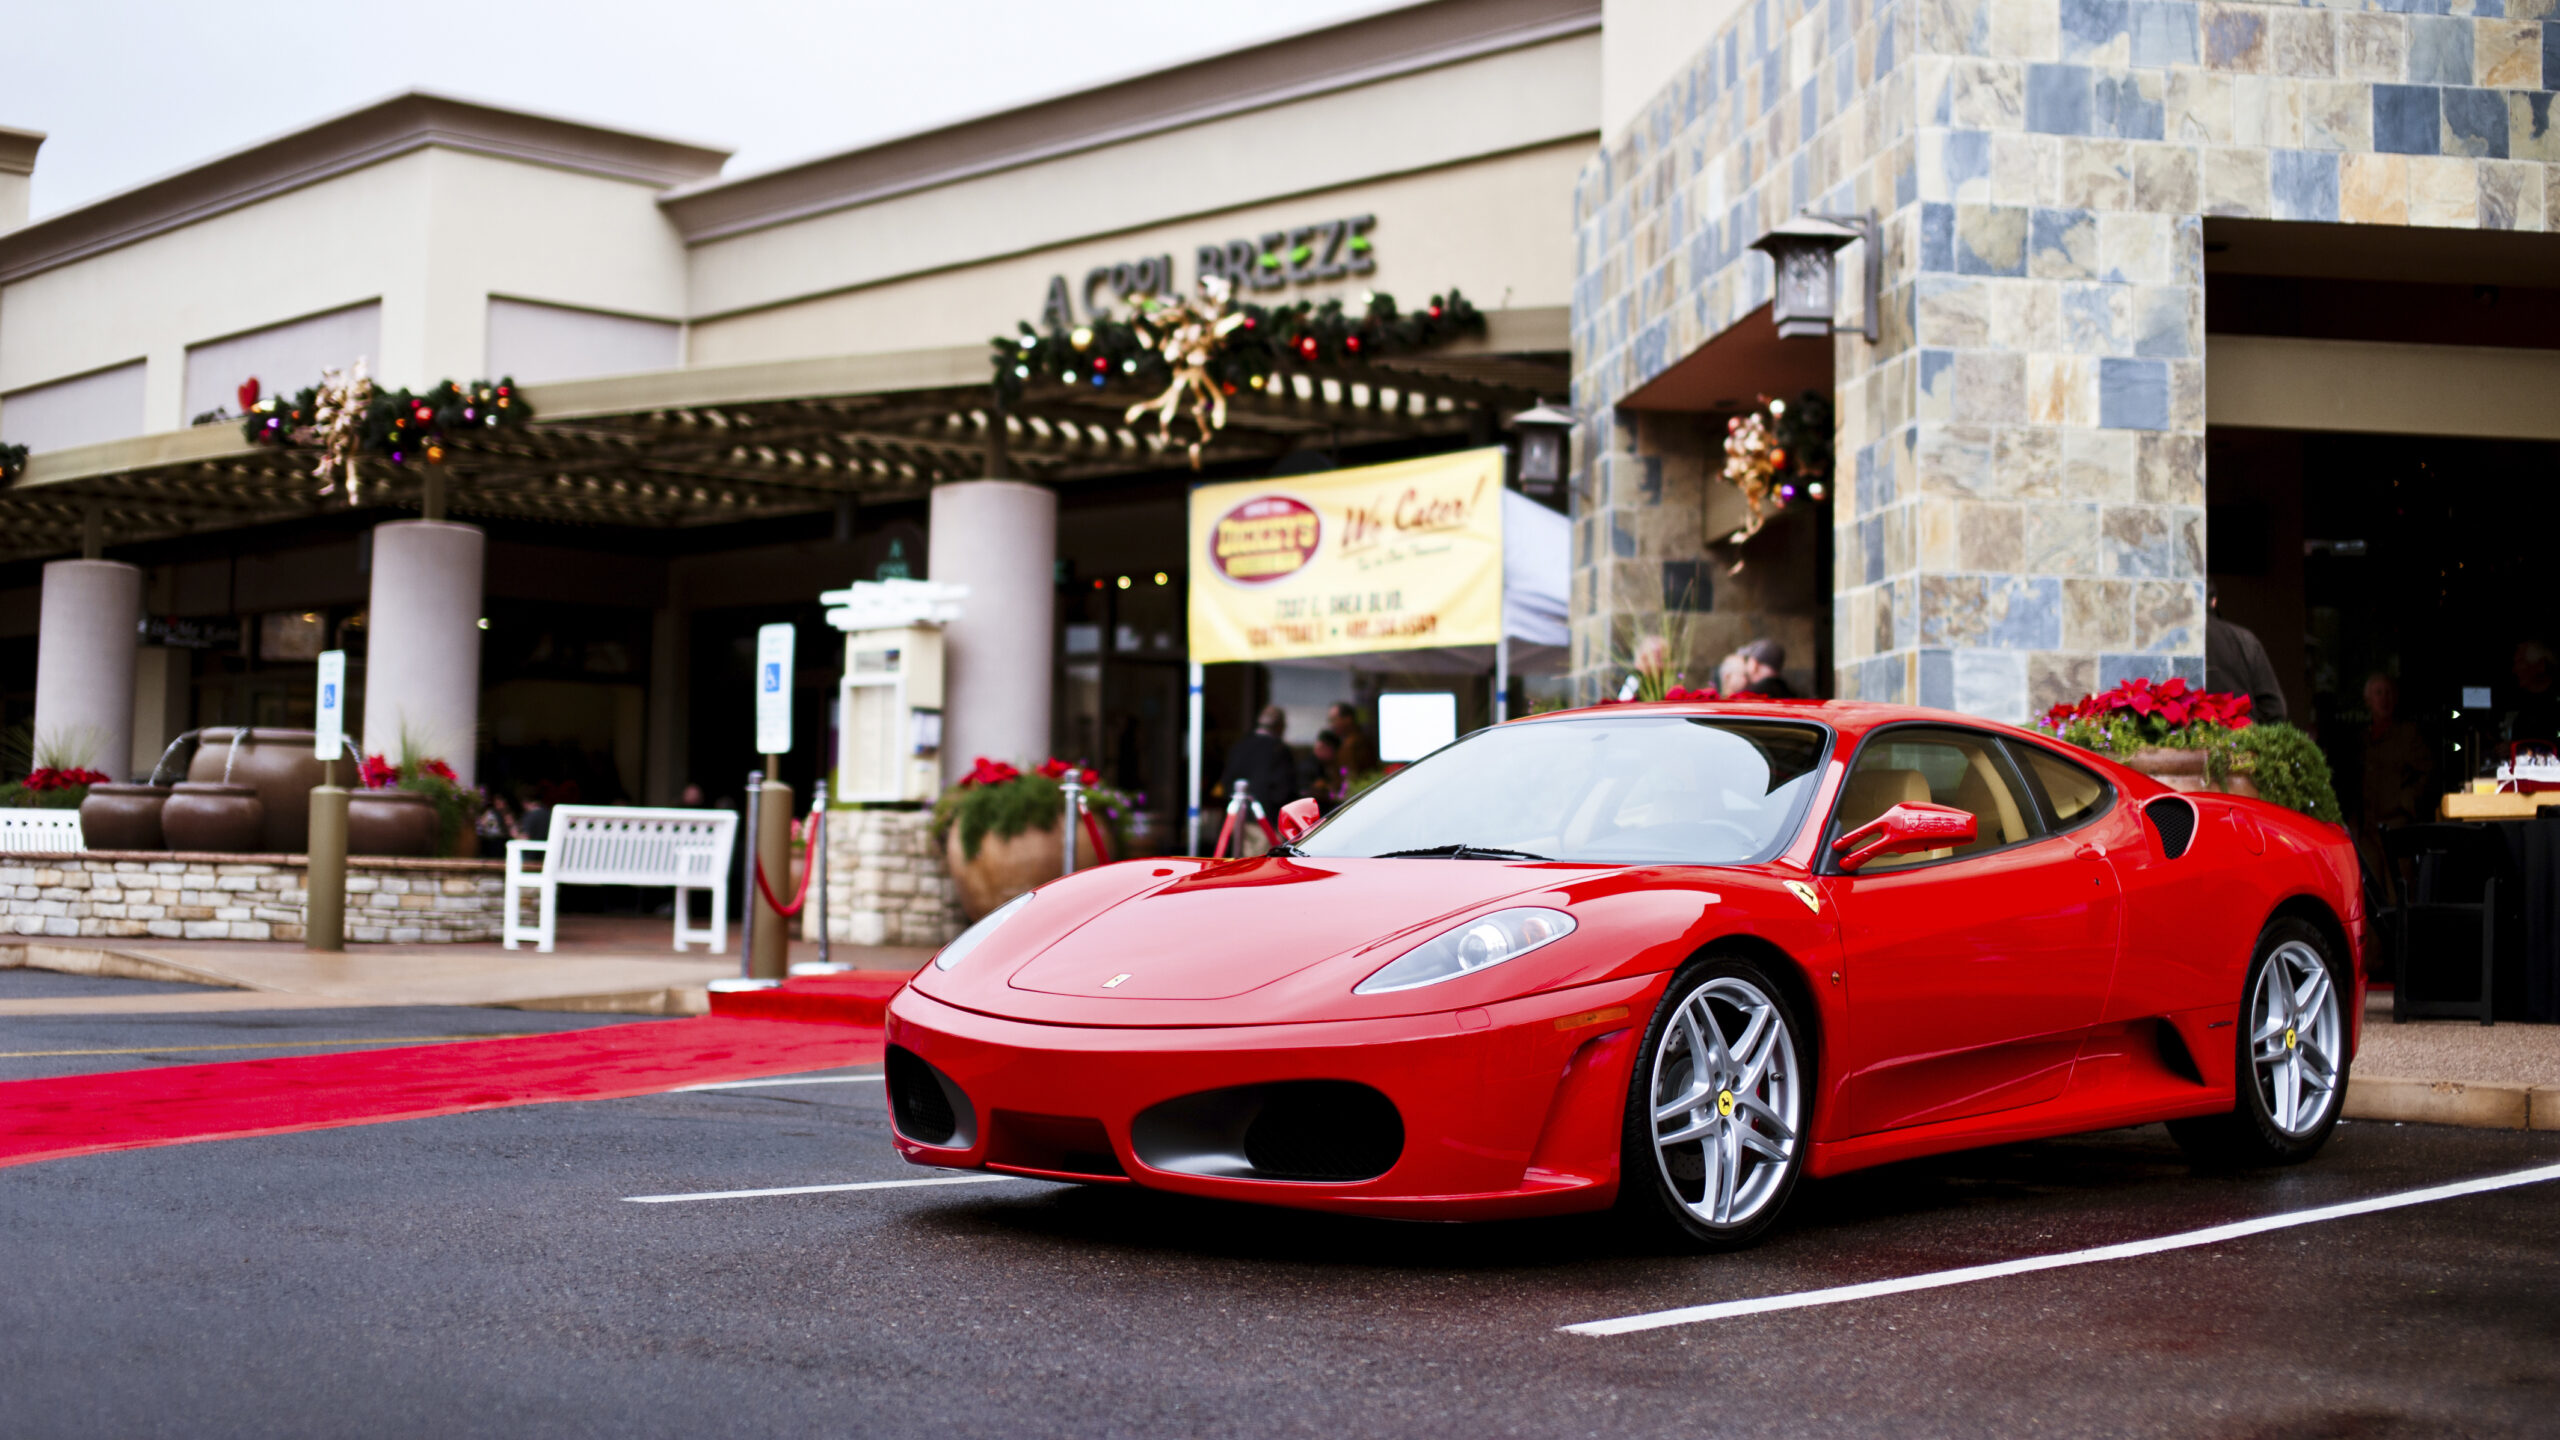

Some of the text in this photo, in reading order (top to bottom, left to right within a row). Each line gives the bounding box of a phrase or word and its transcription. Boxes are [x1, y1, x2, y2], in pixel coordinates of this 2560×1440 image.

[1042, 214, 1376, 327] A COOL BREEZE
[1394, 475, 1487, 531] Cater!
